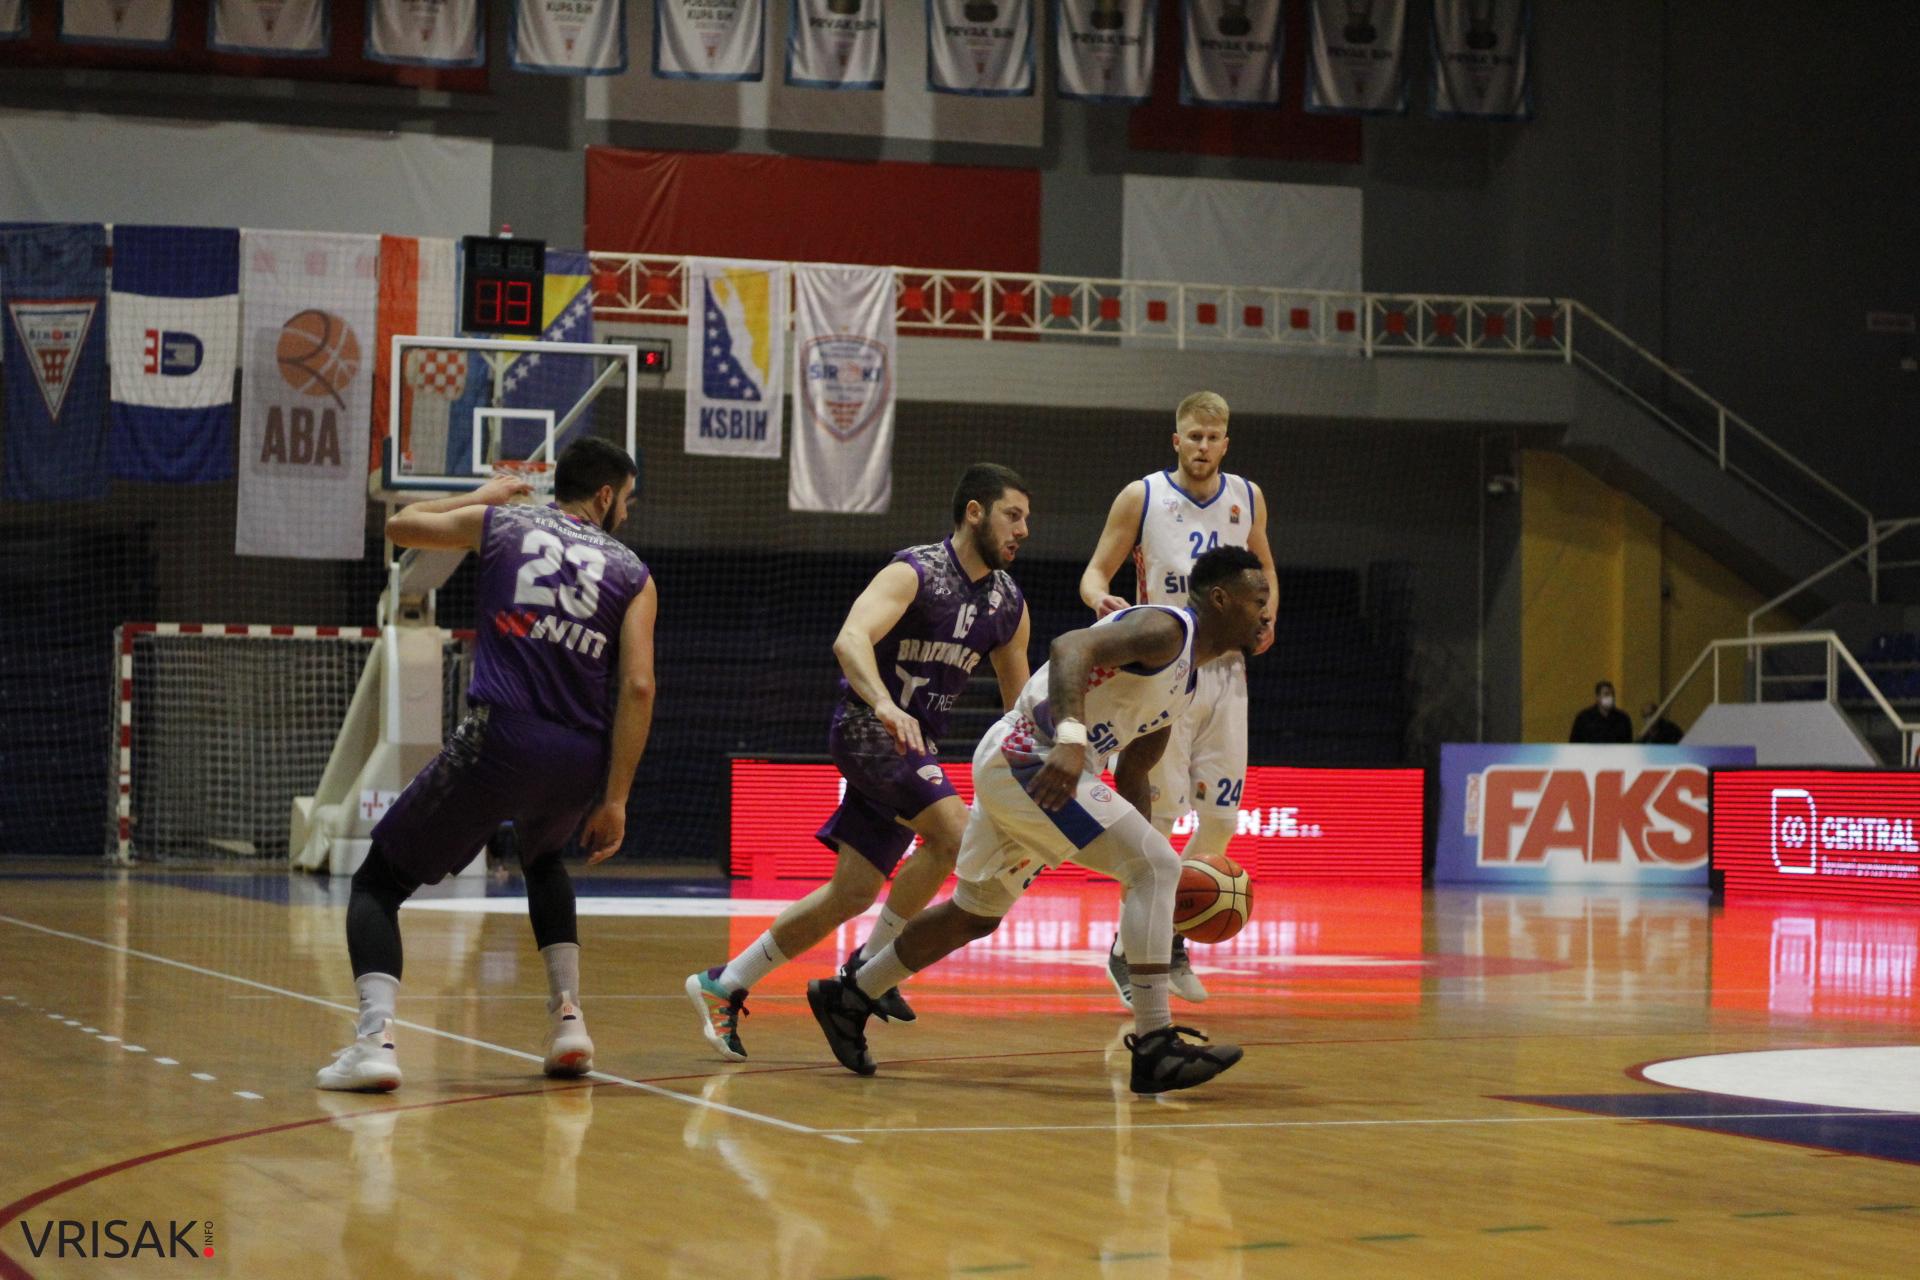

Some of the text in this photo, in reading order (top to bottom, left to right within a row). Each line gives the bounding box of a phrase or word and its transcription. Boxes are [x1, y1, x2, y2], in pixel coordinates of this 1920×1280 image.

[260, 405, 342, 466] ABA
[699, 406, 768, 441] KSBIH
[1189, 531, 1218, 559] 24
[513, 529, 606, 620] 23
[952, 603, 977, 639] 16
[1216, 778, 1243, 807] 24
[1480, 767, 1709, 866] FAKS
[1820, 816, 1919, 852] CENTRAL
